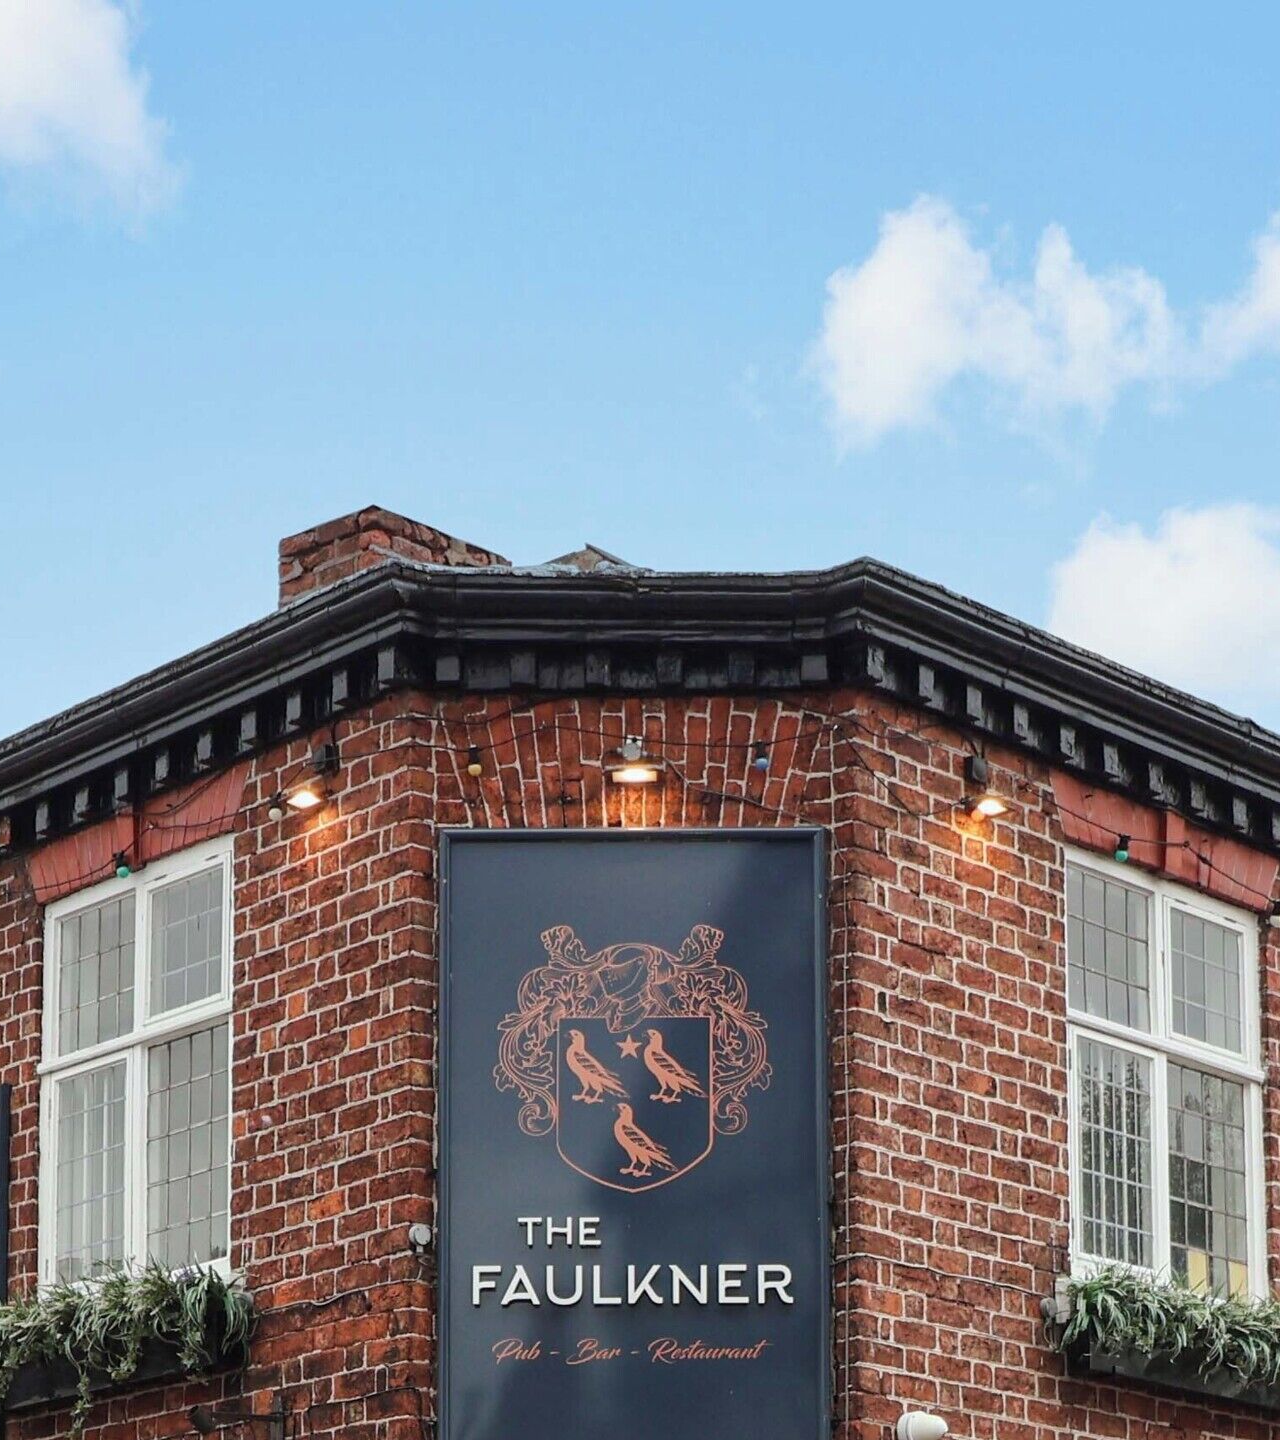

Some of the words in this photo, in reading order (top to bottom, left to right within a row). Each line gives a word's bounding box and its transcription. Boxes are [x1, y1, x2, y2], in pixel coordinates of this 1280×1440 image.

[517, 1216, 602, 1246] THE
[471, 1263, 795, 1306] FAULKNER
[491, 1338, 541, 1365] Pub
[566, 1338, 622, 1365] Bar
[648, 1337, 774, 1365] Restaurant
